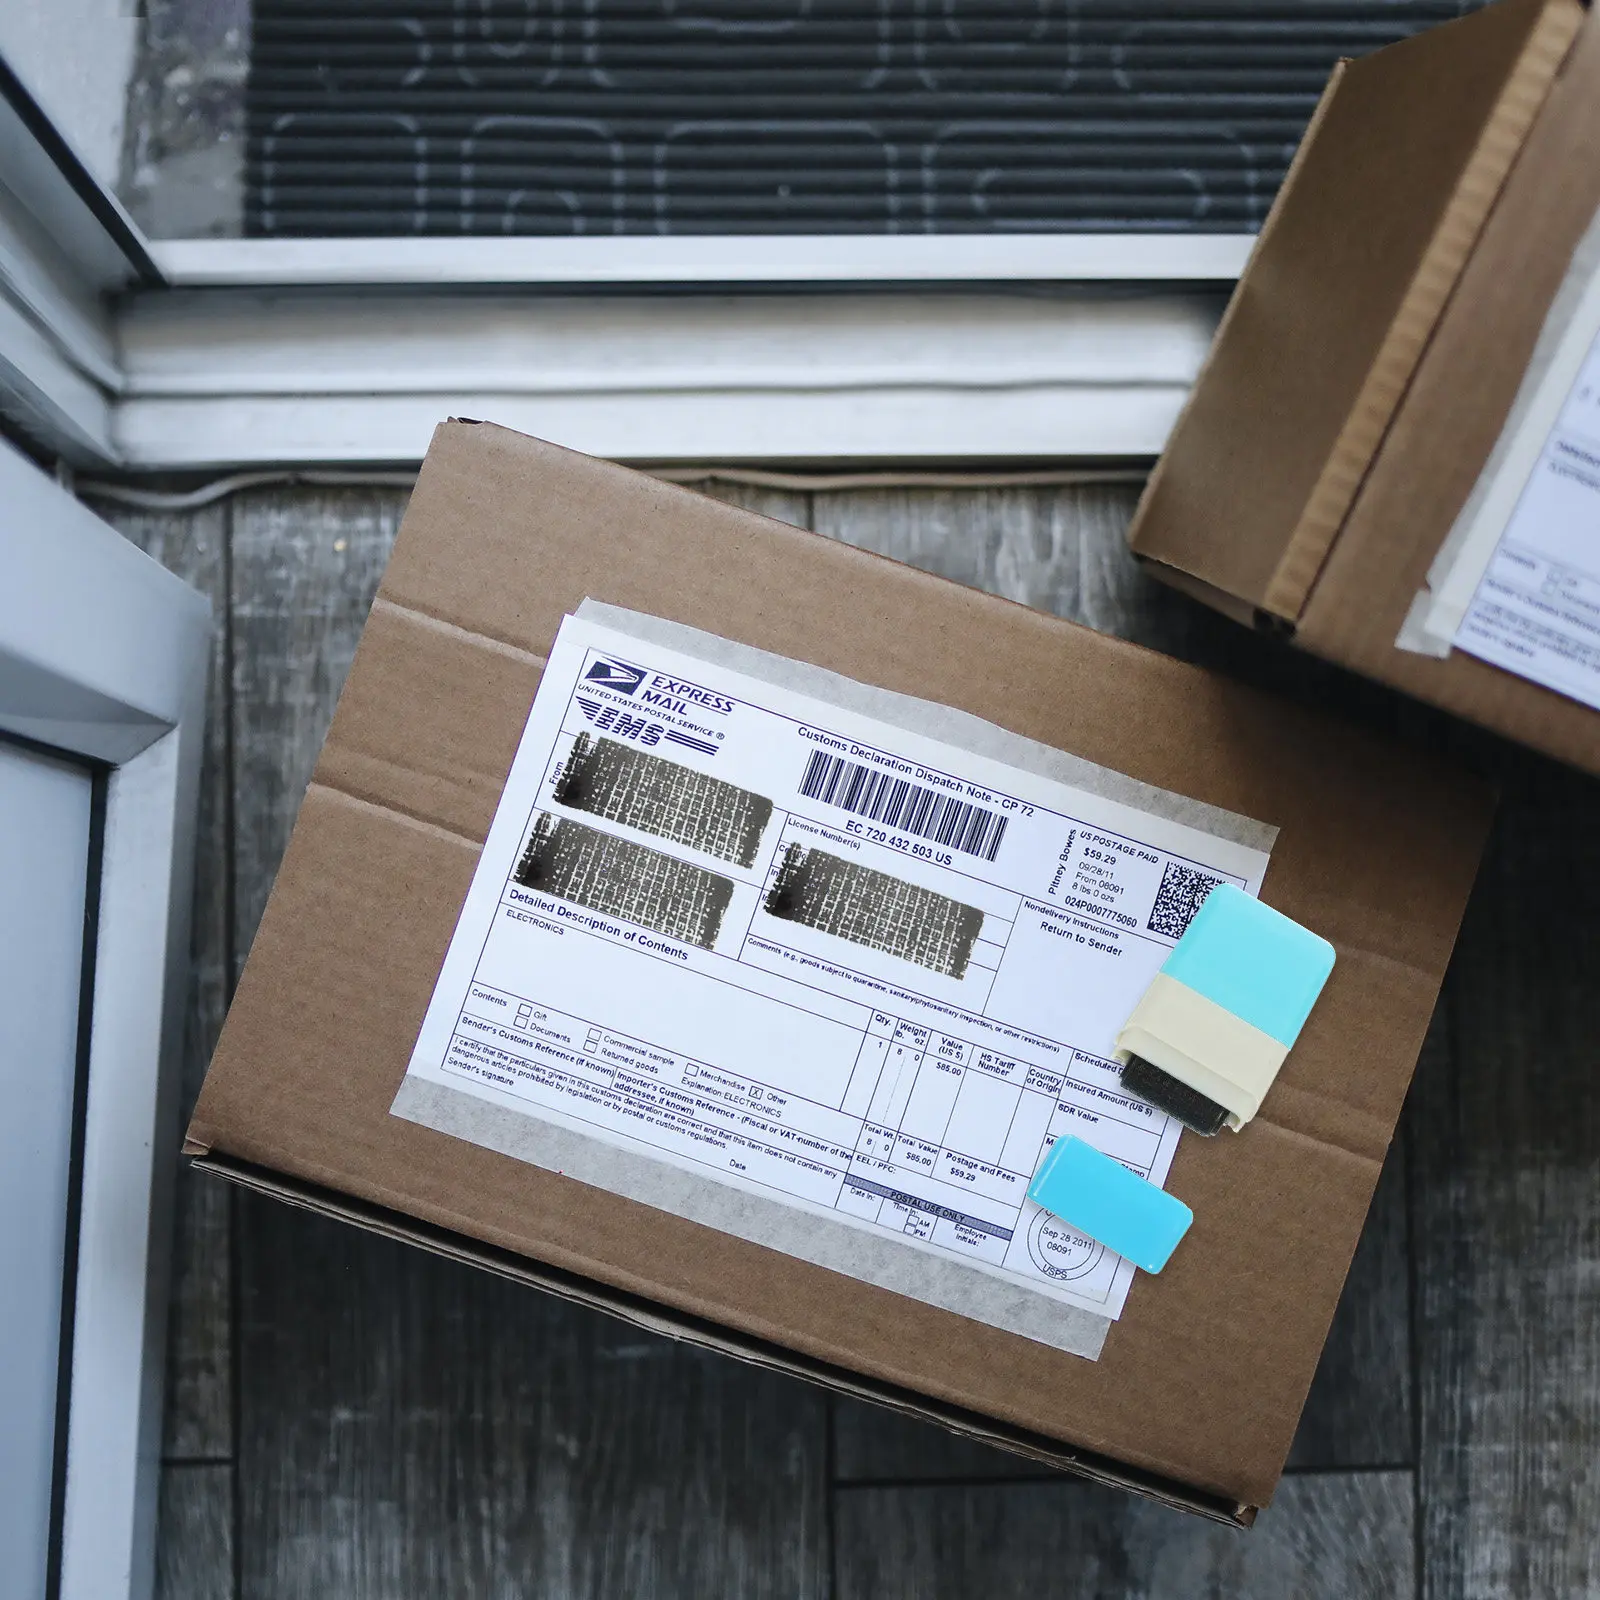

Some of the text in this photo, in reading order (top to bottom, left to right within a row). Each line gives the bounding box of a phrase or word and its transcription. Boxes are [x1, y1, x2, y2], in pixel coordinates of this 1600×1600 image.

[641, 690, 687, 715] MAIL
[651, 676, 735, 712] EXPRESS
[578, 684, 714, 736] UNITED STATES POSTAL SERVICE
[594, 705, 664, 746] EMS
[549, 762, 563, 785] From
[798, 727, 1034, 817] Customs Declaration Dispatch Note CP 72
[788, 818, 860, 850] License Number(s)
[846, 820, 952, 865] EC 720 432 503 US
[1080, 831, 1159, 864] US POSTAGE PAID
[1084, 847, 1116, 865] $59.29
[1048, 829, 1076, 895] Pitney Bowes
[1079, 862, 1113, 879] 09/28/11
[1072, 882, 1115, 903] 8 lbs 0 ozs
[1075, 871, 1124, 895] From 08091
[506, 909, 564, 935] ELECTRONICS
[1024, 901, 1119, 939] Nondelivery Instructions
[1065, 895, 1137, 928] 024P0007775060
[510, 889, 688, 960] Detailed Description of Contents
[1040, 921, 1122, 956] Return to Sender
[472, 989, 507, 1006] Contents
[534, 1011, 547, 1021] Gift
[875, 1014, 891, 1026] Qty.
[530, 1023, 570, 1043] Documents
[900, 1022, 927, 1037] Weight
[462, 1016, 497, 1034] Sender's
[499, 1030, 533, 1047] Customs
[535, 1043, 575, 1062] Reference
[585, 1061, 616, 1078] known)
[604, 1035, 674, 1065] Commercial sample
[938, 1046, 963, 1061] (US $)
[942, 1037, 963, 1050] Value
[448, 1057, 514, 1086] Sender's signature
[601, 1048, 658, 1074] Returned goods
[936, 1062, 961, 1076] $85.00
[978, 1060, 1010, 1076] Number
[980, 1053, 1016, 1070] HS Tariff
[1075, 1052, 1117, 1072] Scheduled
[700, 1070, 745, 1091] Merchandise
[1029, 1069, 1062, 1087] Country
[1036, 1080, 1061, 1096] Origin
[452, 1046, 489, 1064] dangerous
[518, 1070, 554, 1087] prohibited
[566, 1086, 602, 1104] legislation
[622, 1108, 645, 1119] postal
[656, 1119, 686, 1134] customs
[614, 1082, 657, 1103] addressee,
[665, 1100, 694, 1116] known)
[767, 1093, 787, 1105] Other
[1066, 1080, 1152, 1117] Insured Amount (US $)
[459, 1040, 837, 1179] certify that the particulars given this customs declaration correct and that this does not contain any
[617, 1071, 657, 1091] Importer's
[659, 1087, 694, 1104] Customs
[695, 1099, 735, 1119] Reference
[741, 1116, 768, 1130] (Fiscal
[780, 1129, 829, 1152] VAT-number
[840, 1151, 852, 1161] the
[1058, 1103, 1098, 1123] SDR Value
[865, 1124, 894, 1139] Total Wt.
[898, 1135, 938, 1154] Total Value
[729, 1159, 746, 1170] Date
[856, 1155, 896, 1173] EEL PFC:
[906, 1152, 931, 1166] $85.00
[946, 1152, 1015, 1182] Postage and Fees
[950, 1167, 975, 1181] $59.29
[889, 1191, 966, 1224] POSTAL USE ONLY
[954, 1224, 987, 1240] Employee
[1042, 1227, 1092, 1249] Sep 28 2011
[1047, 1241, 1072, 1255] 08091
[1041, 1264, 1067, 1281] USPS
